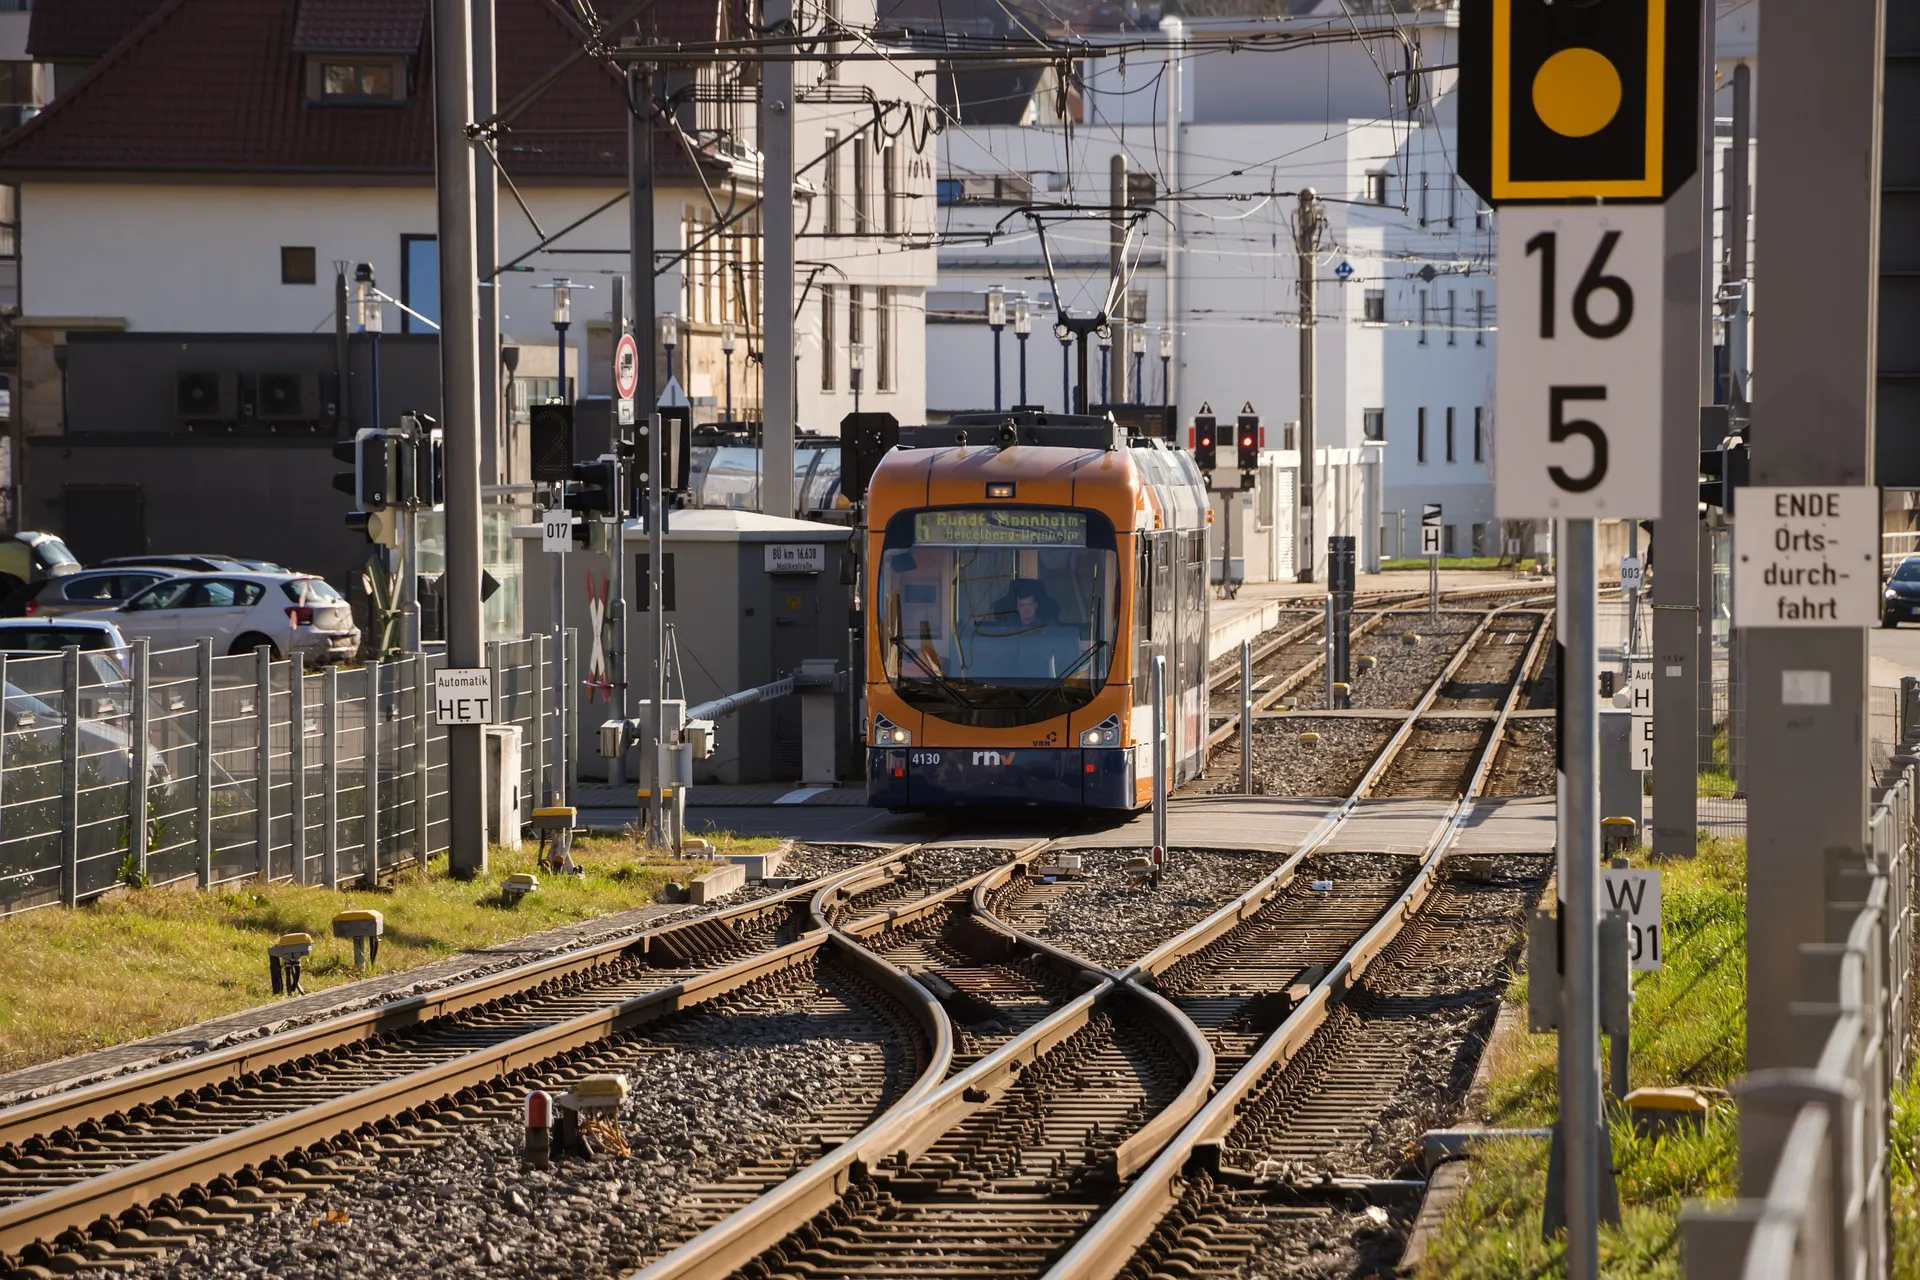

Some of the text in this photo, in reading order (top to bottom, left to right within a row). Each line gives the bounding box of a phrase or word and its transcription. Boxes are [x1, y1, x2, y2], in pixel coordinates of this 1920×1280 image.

[1525, 230, 1634, 340] 16
[1547, 385, 1608, 493] 5
[374, 493, 381, 501] 6
[1775, 493, 1840, 518] ENDE
[547, 523, 568, 539] 017
[1424, 529, 1439, 551] H
[1775, 528, 1838, 551] Orts-
[773, 546, 782, 560] BÜ
[784, 548, 794, 560] km
[1621, 567, 1640, 579] 003
[1764, 561, 1850, 586] durch-
[1777, 596, 1837, 620] fahrt
[438, 675, 488, 688] Automatik
[438, 698, 489, 720] HET
[912, 751, 1016, 766] 4130 rnv
[1605, 879, 1646, 915] W
